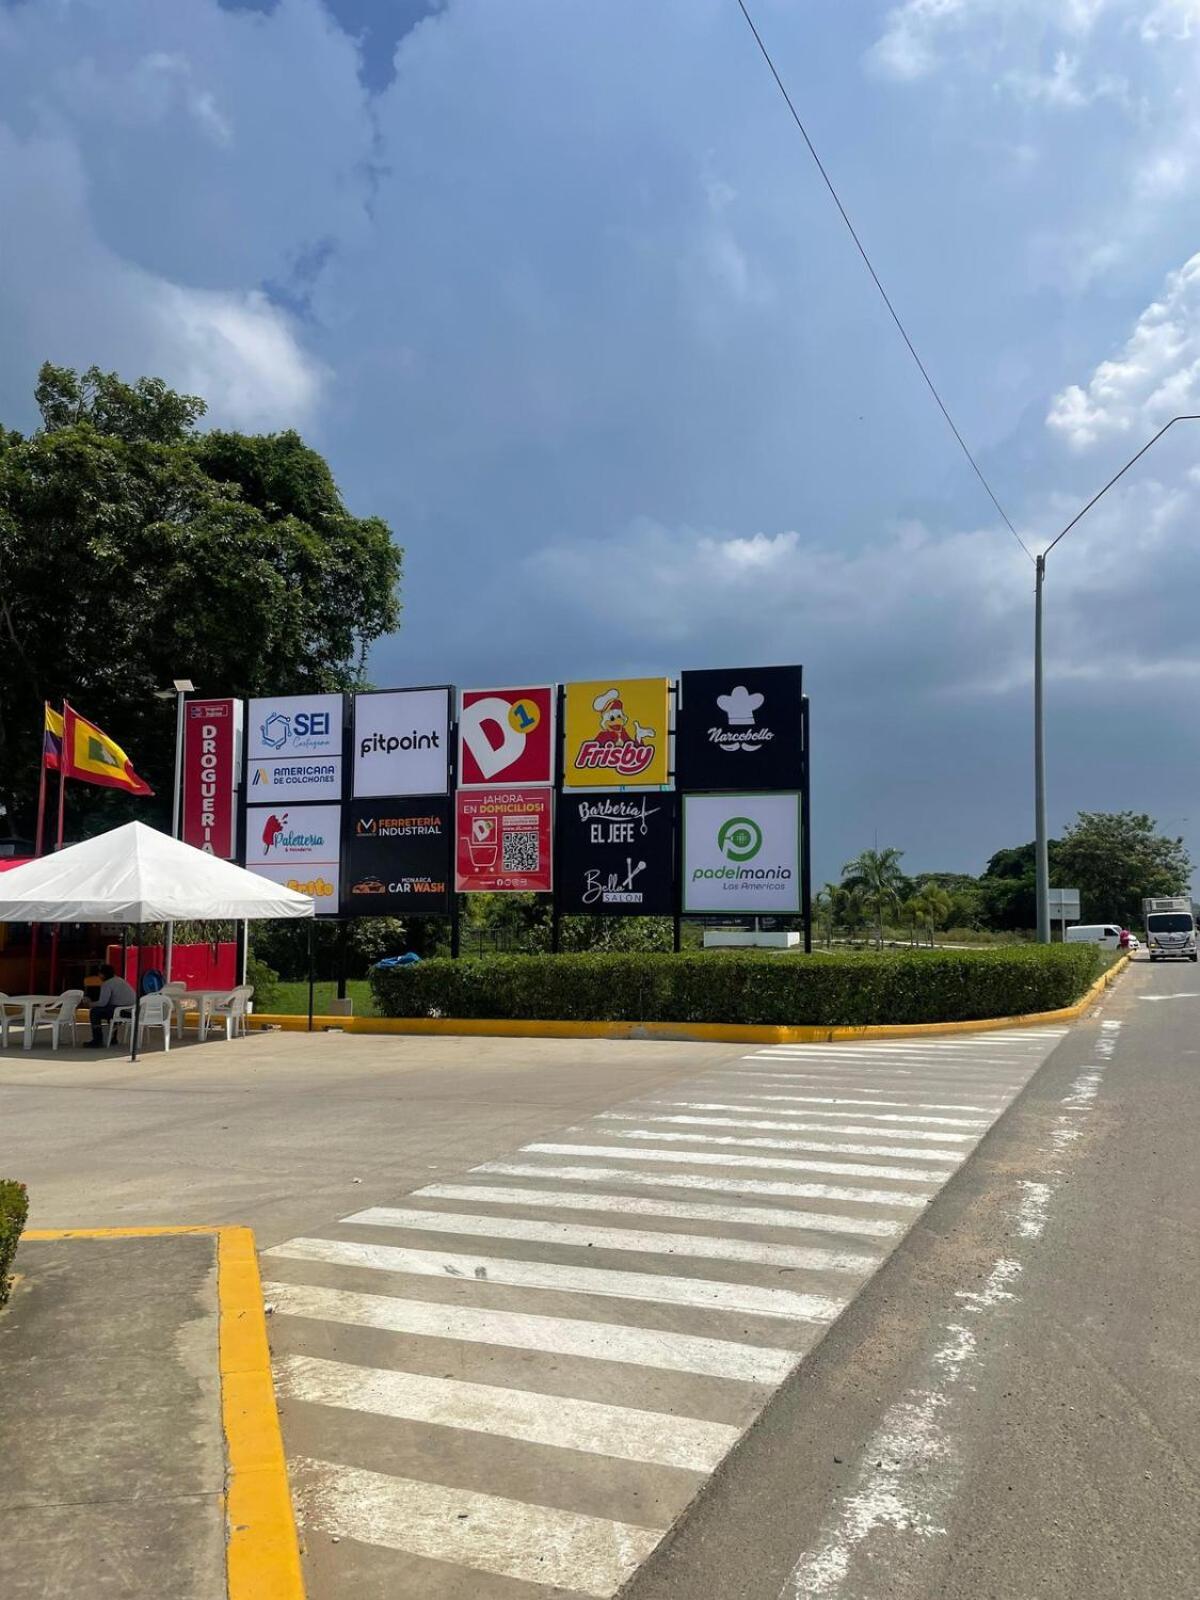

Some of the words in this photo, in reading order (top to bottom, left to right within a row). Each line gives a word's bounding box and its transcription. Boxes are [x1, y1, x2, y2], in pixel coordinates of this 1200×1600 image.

[293, 712, 330, 736] SEI
[463, 697, 540, 779] D1
[575, 740, 656, 775] Frisby
[273, 765, 335, 777] AMERICANA
[273, 777, 285, 785] DE
[285, 775, 335, 784] COLCHONES
[201, 725, 217, 856] DROGUERIA
[463, 805, 477, 814] EN
[479, 803, 544, 813] DOMICILIOS!
[378, 826, 442, 837] INDUSTRIAL
[591, 823, 605, 843] EL
[607, 823, 635, 843] JEFE
[692, 866, 792, 882] padelmania
[388, 883, 411, 893] CAR
[413, 882, 445, 893] WASH
[582, 868, 625, 904] Bella
[723, 882, 739, 890] Las
